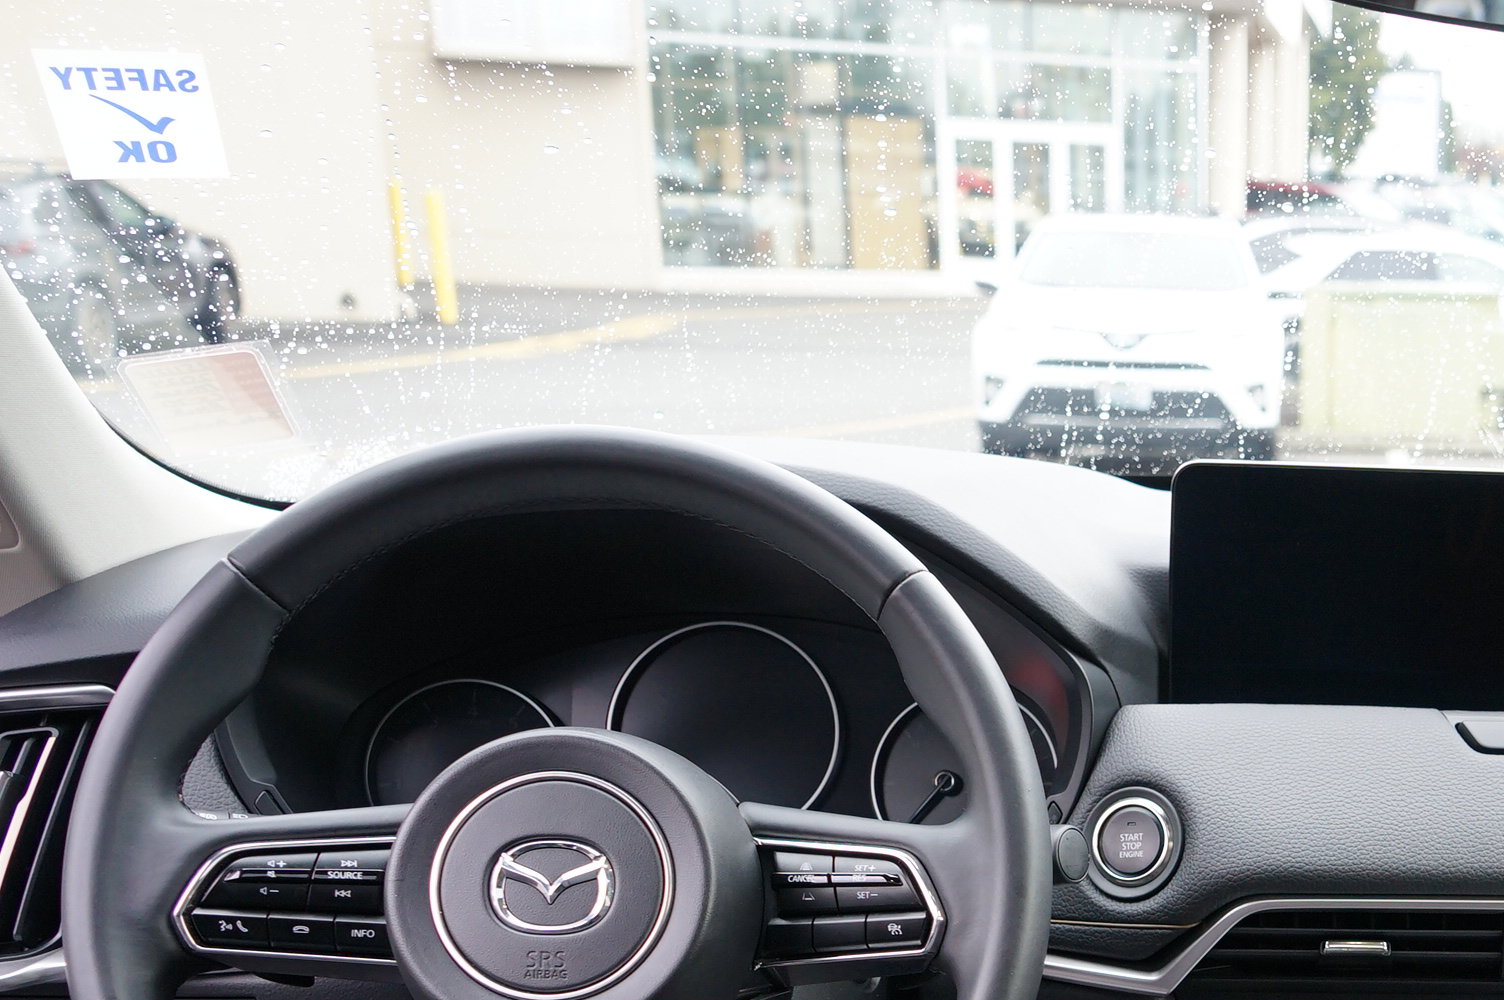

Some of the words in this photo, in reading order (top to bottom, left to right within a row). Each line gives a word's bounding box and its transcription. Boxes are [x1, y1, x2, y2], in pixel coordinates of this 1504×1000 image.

[1119, 832, 1144, 842] START
[1121, 842, 1143, 851] STOP
[1119, 850, 1144, 859] ENGINE
[327, 871, 363, 880] SOURCE
[787, 874, 815, 883] CANCEL
[350, 928, 376, 939] INFO
[525, 950, 567, 969] SRS
[523, 969, 569, 980] AIRBAG
